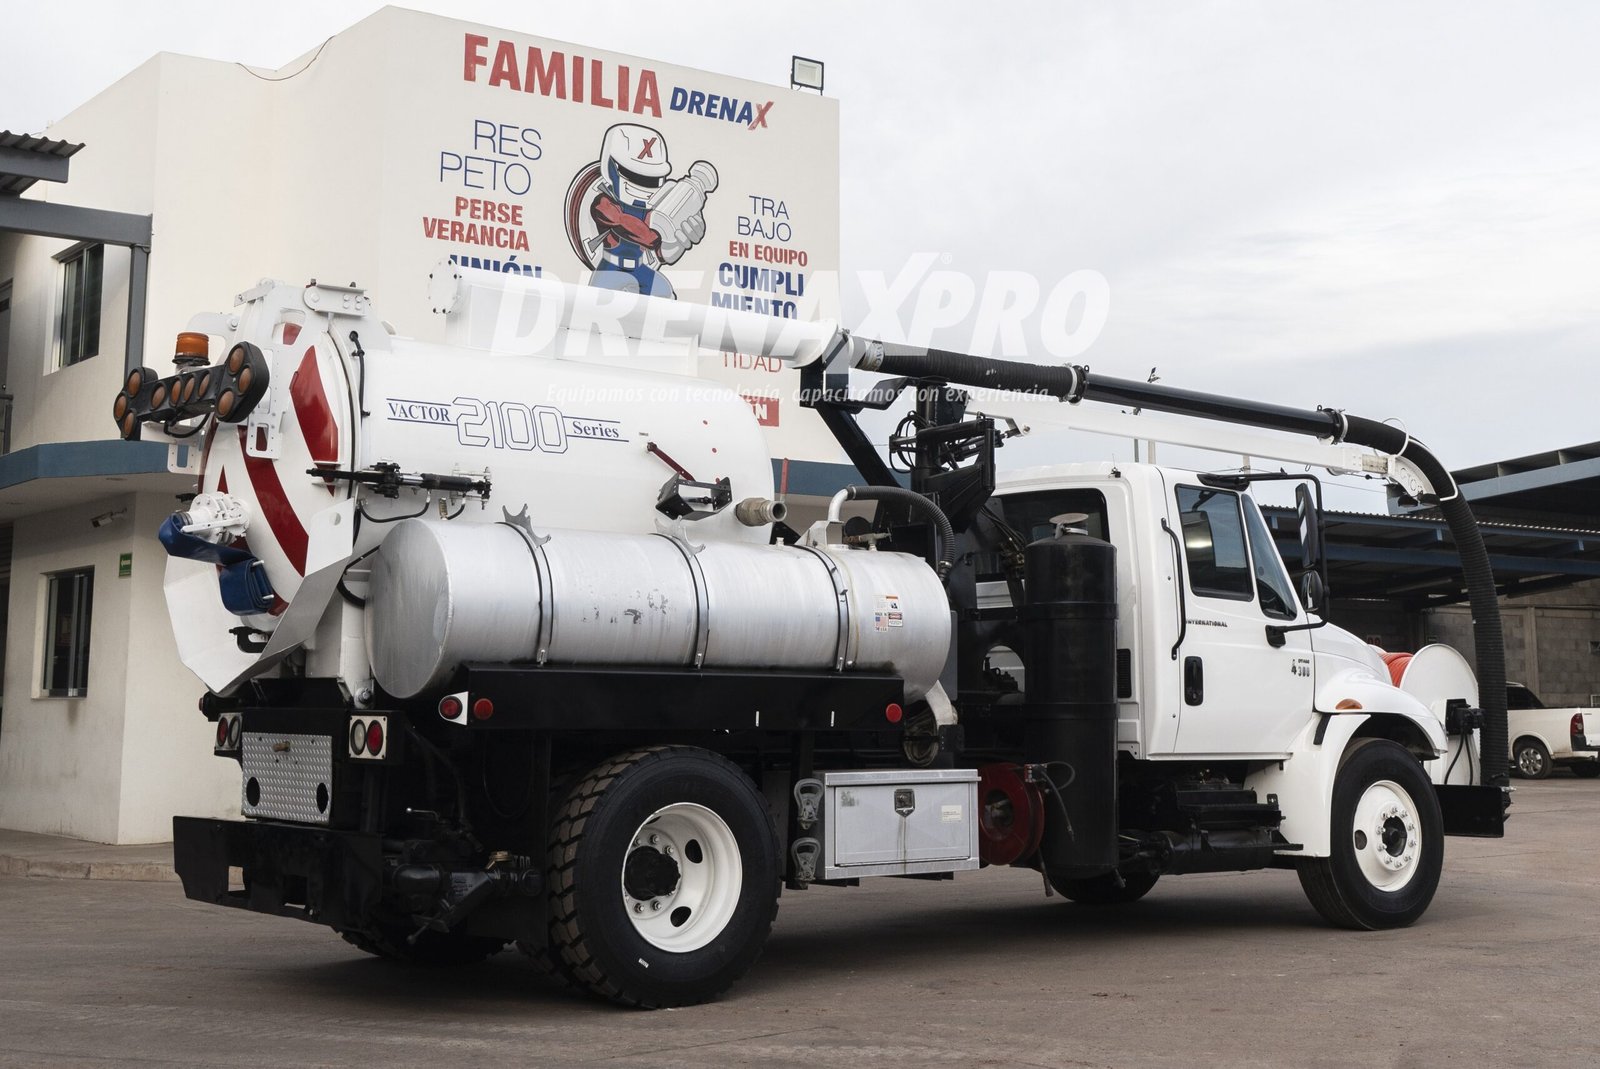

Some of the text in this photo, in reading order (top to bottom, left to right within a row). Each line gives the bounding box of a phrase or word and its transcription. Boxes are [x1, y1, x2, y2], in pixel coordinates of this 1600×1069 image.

[464, 32, 775, 131] FAMILIA DRENAX
[474, 119, 542, 161] RES
[637, 136, 657, 160] X
[439, 151, 531, 195] PETO
[455, 195, 523, 226] PERSE
[749, 195, 790, 220] TRA
[422, 216, 530, 252] VERANCIA
[737, 215, 792, 242] BAJO
[729, 240, 808, 267] EN EQUIPO
[718, 262, 804, 297] CUMPLI
[387, 396, 619, 454] VACTOR 2100 Series
